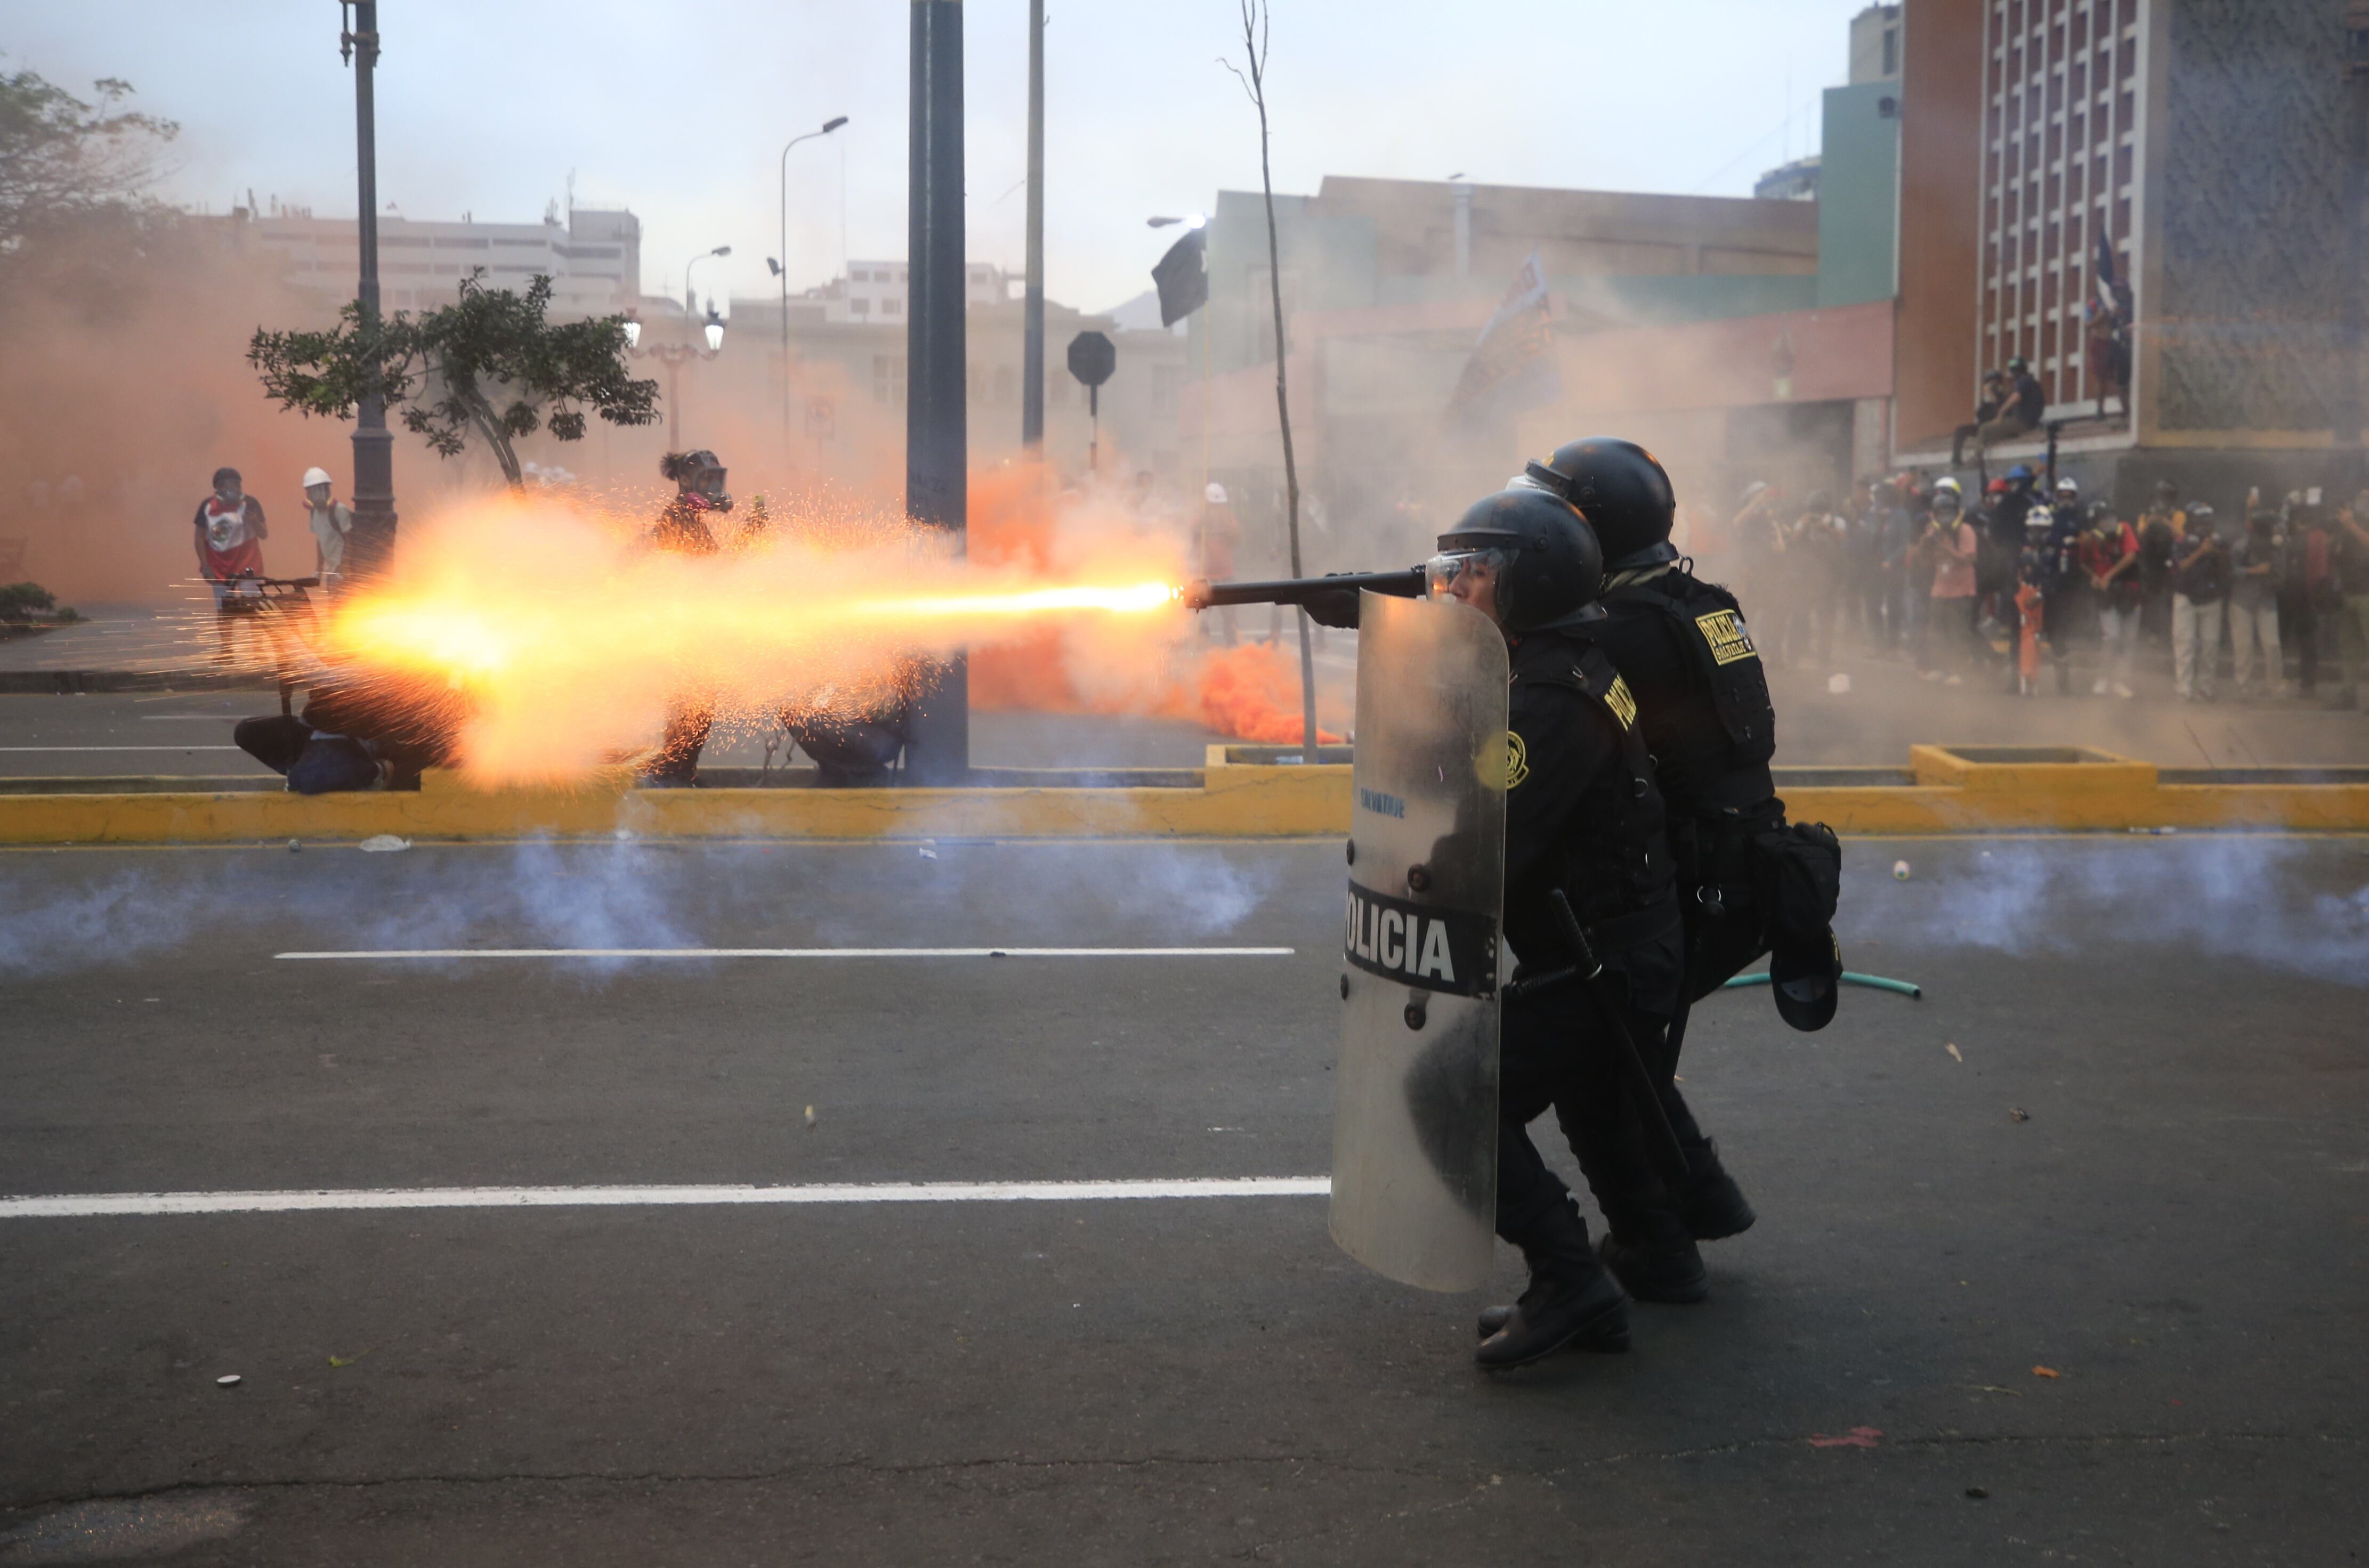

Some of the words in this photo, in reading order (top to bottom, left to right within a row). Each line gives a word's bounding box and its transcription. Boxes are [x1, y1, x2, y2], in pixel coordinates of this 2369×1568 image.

[1699, 614, 1741, 647] POLICIA
[1604, 672, 1637, 731] POLICI
[1346, 891, 1456, 982] OLICIA
